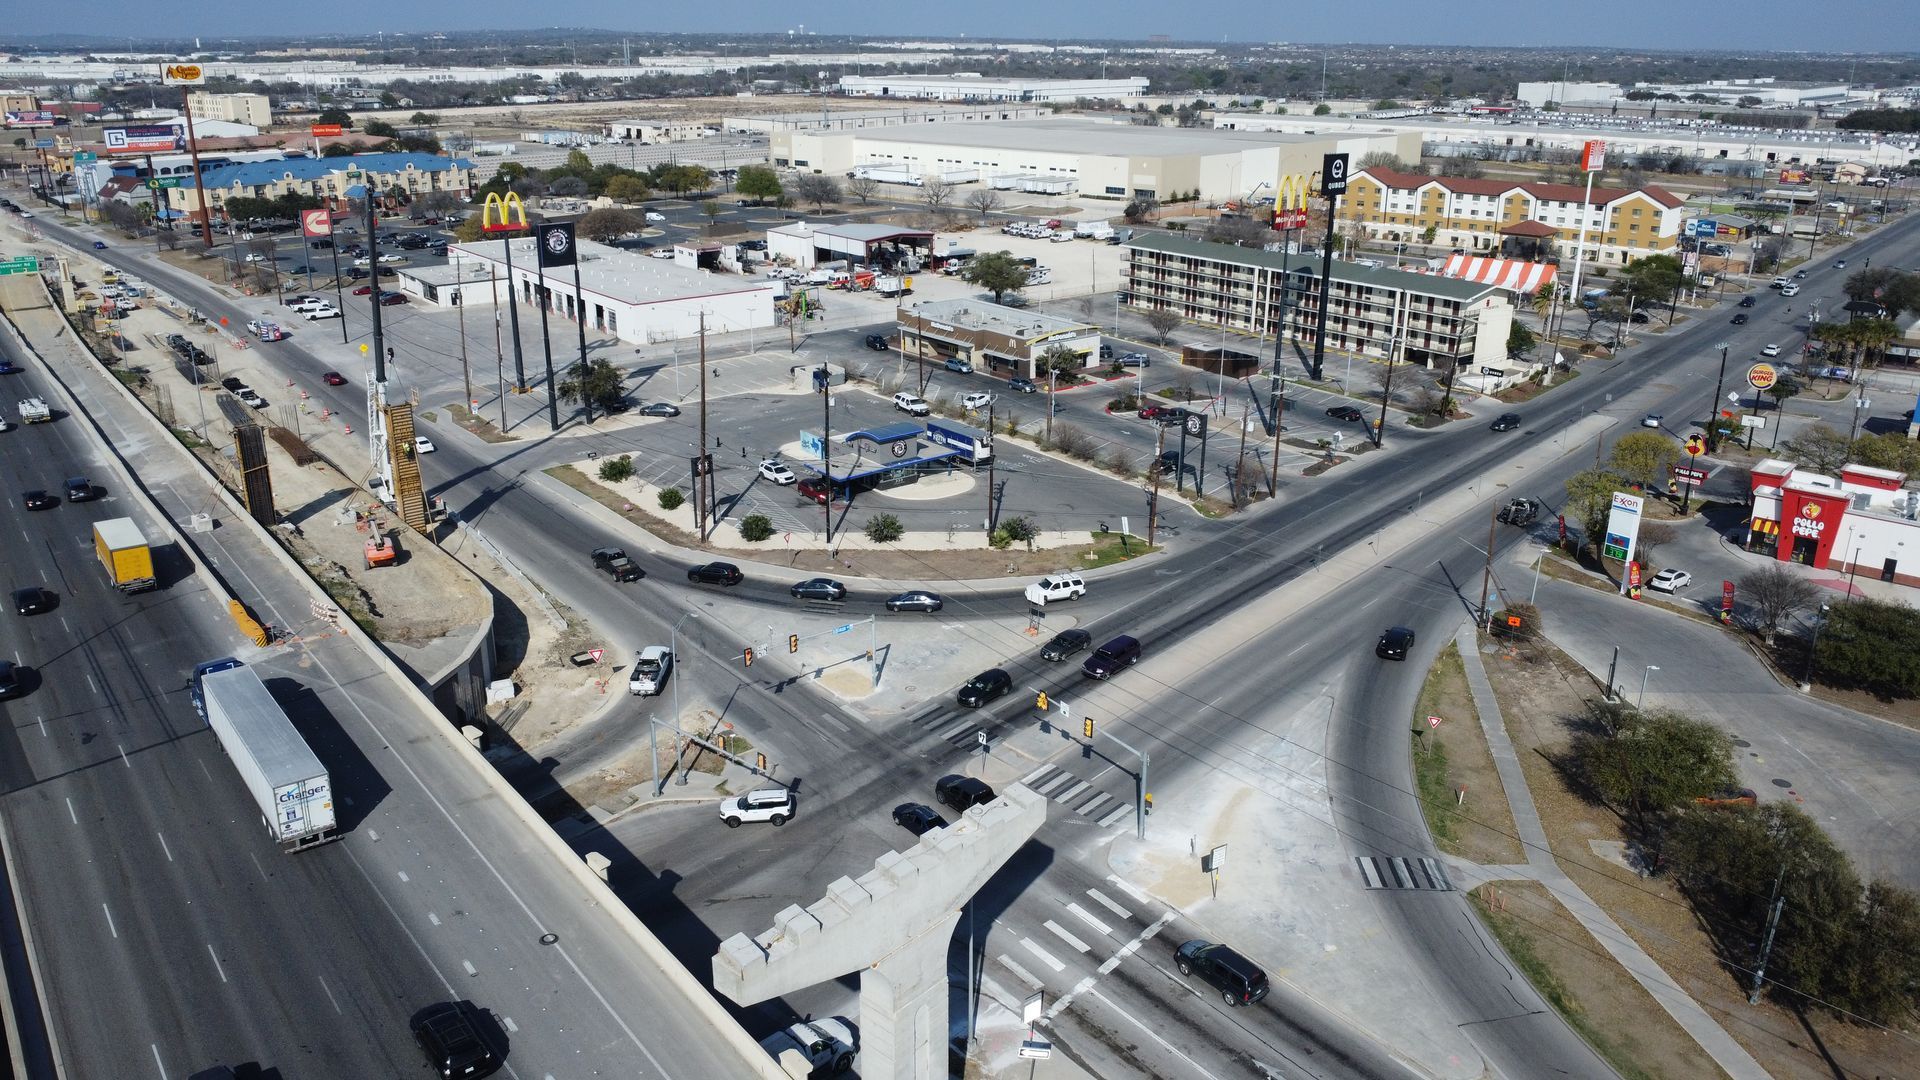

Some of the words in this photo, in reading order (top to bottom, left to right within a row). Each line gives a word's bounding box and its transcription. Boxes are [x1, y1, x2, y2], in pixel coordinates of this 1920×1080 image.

[1751, 374, 1774, 382] KING
[1613, 494, 1638, 508] Exxon
[1793, 516, 1825, 531] POLLO
[1791, 525, 1820, 539] PEPE
[280, 785, 326, 802] Charger
